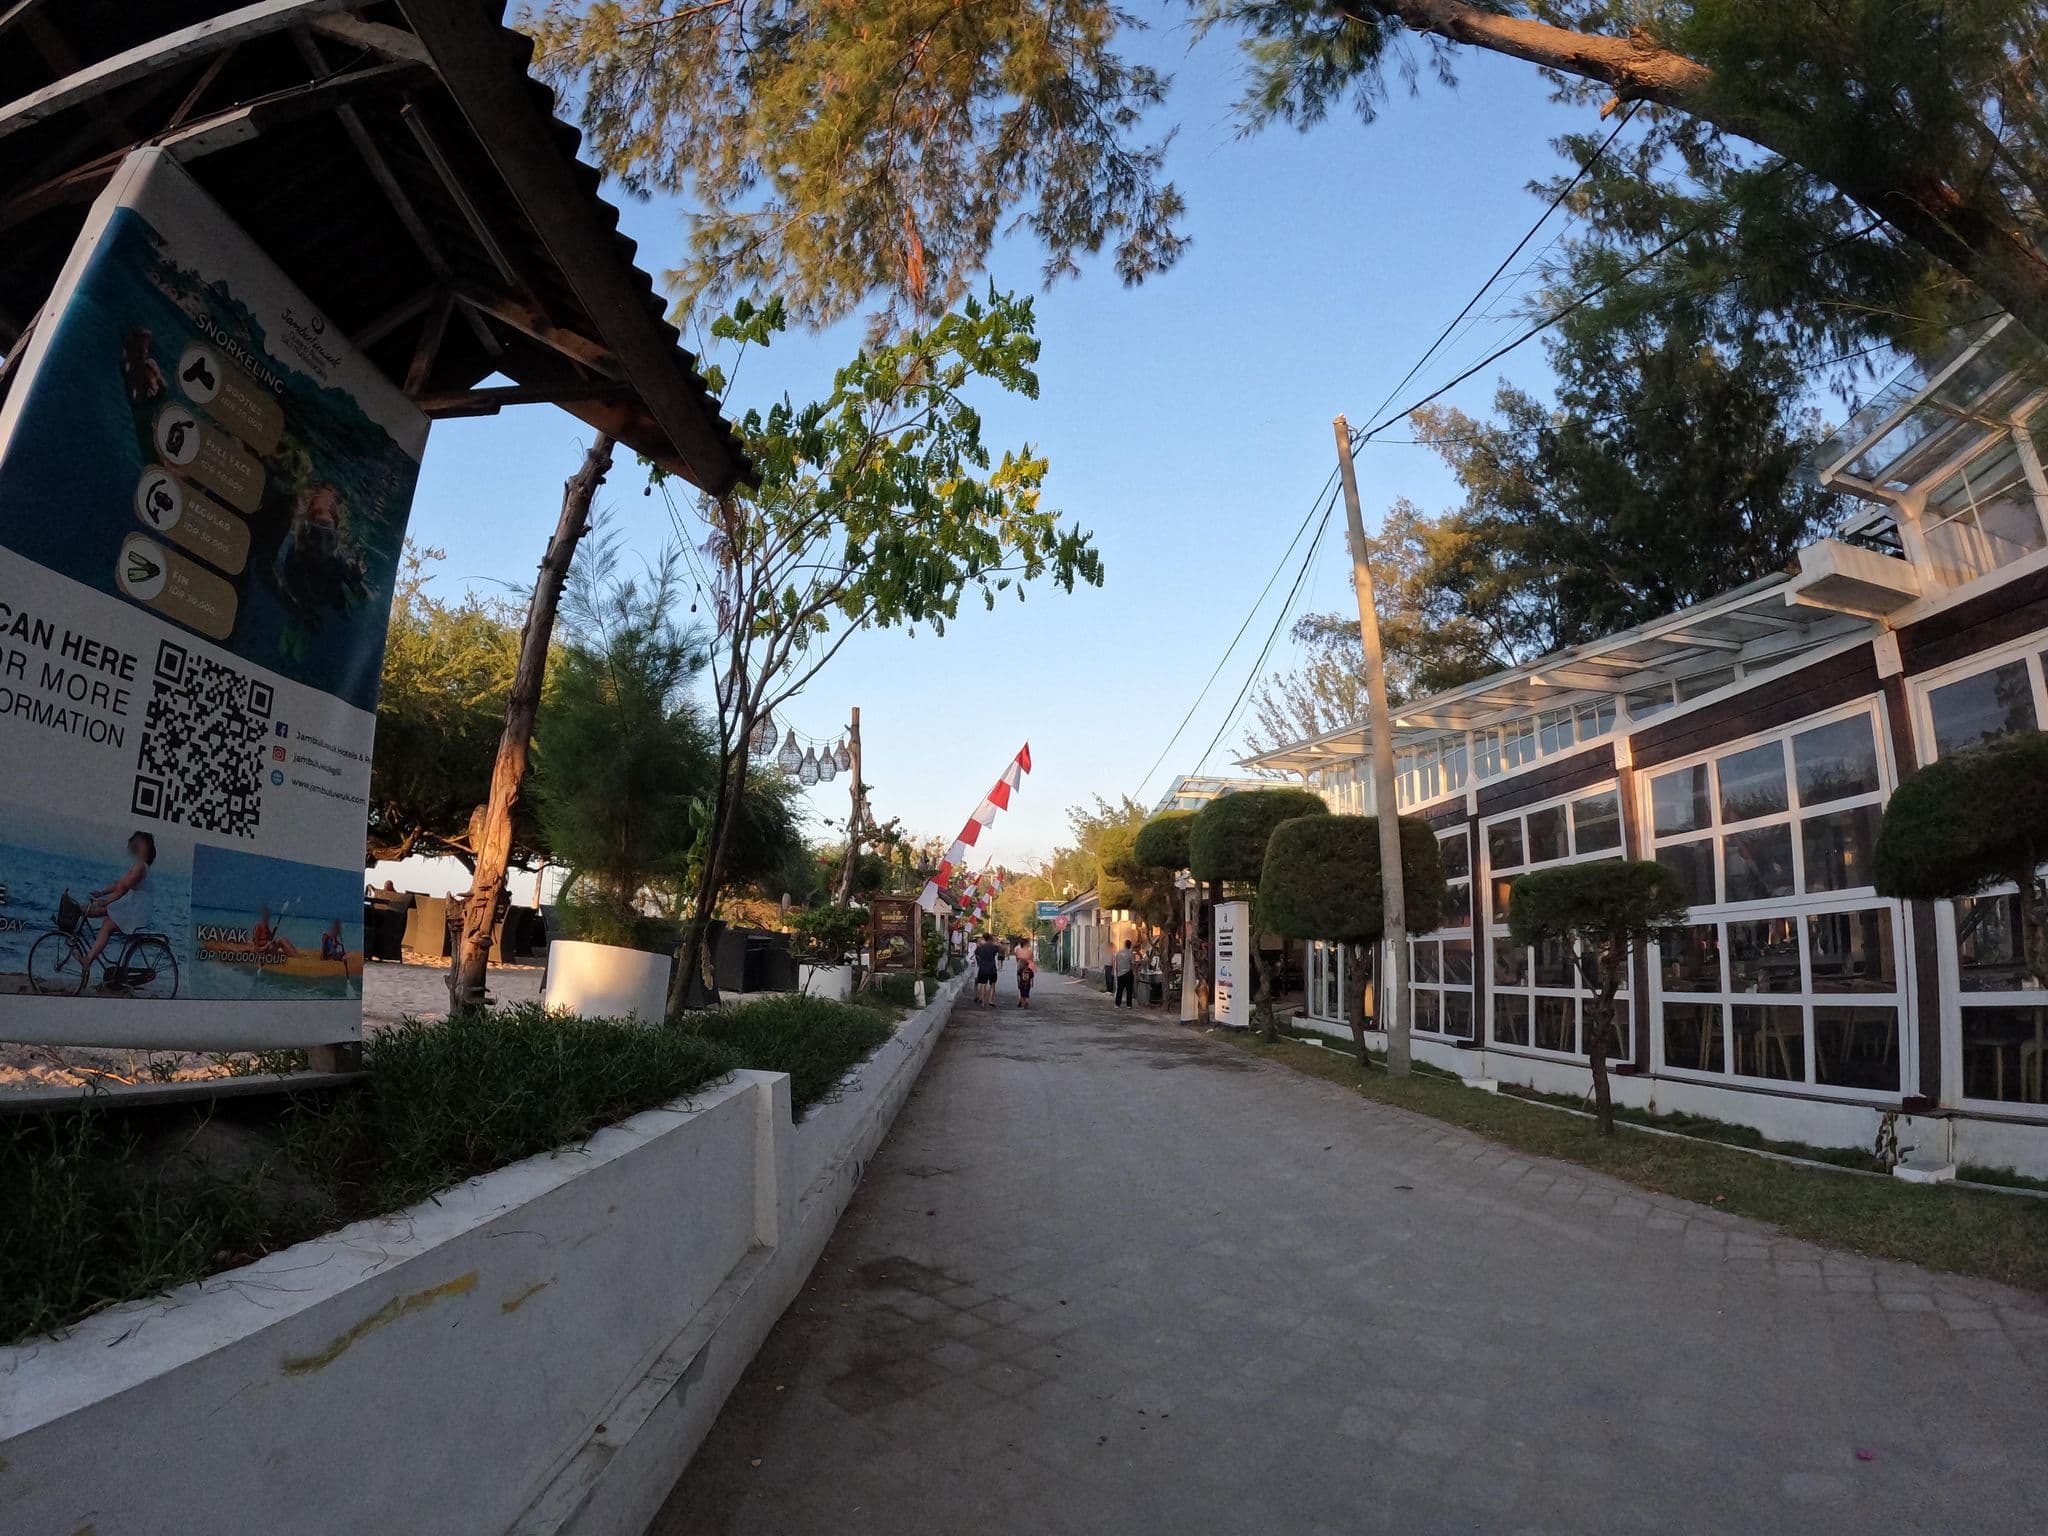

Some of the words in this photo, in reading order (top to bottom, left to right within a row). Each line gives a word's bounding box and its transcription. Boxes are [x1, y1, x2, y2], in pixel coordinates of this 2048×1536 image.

[195, 313, 285, 394] SNORKELING
[225, 383, 264, 416] BOOTIES
[206, 439, 228, 458] FULL
[229, 455, 252, 476] FACE
[188, 500, 232, 532] REGULAR
[168, 584, 185, 599] IDR
[172, 570, 190, 586] FIN
[60, 630, 138, 683] HERE
[40, 661, 131, 717] MORE
[291, 778, 367, 806] www.jambuluwuk.com
[196, 925, 249, 944] KAYAK
